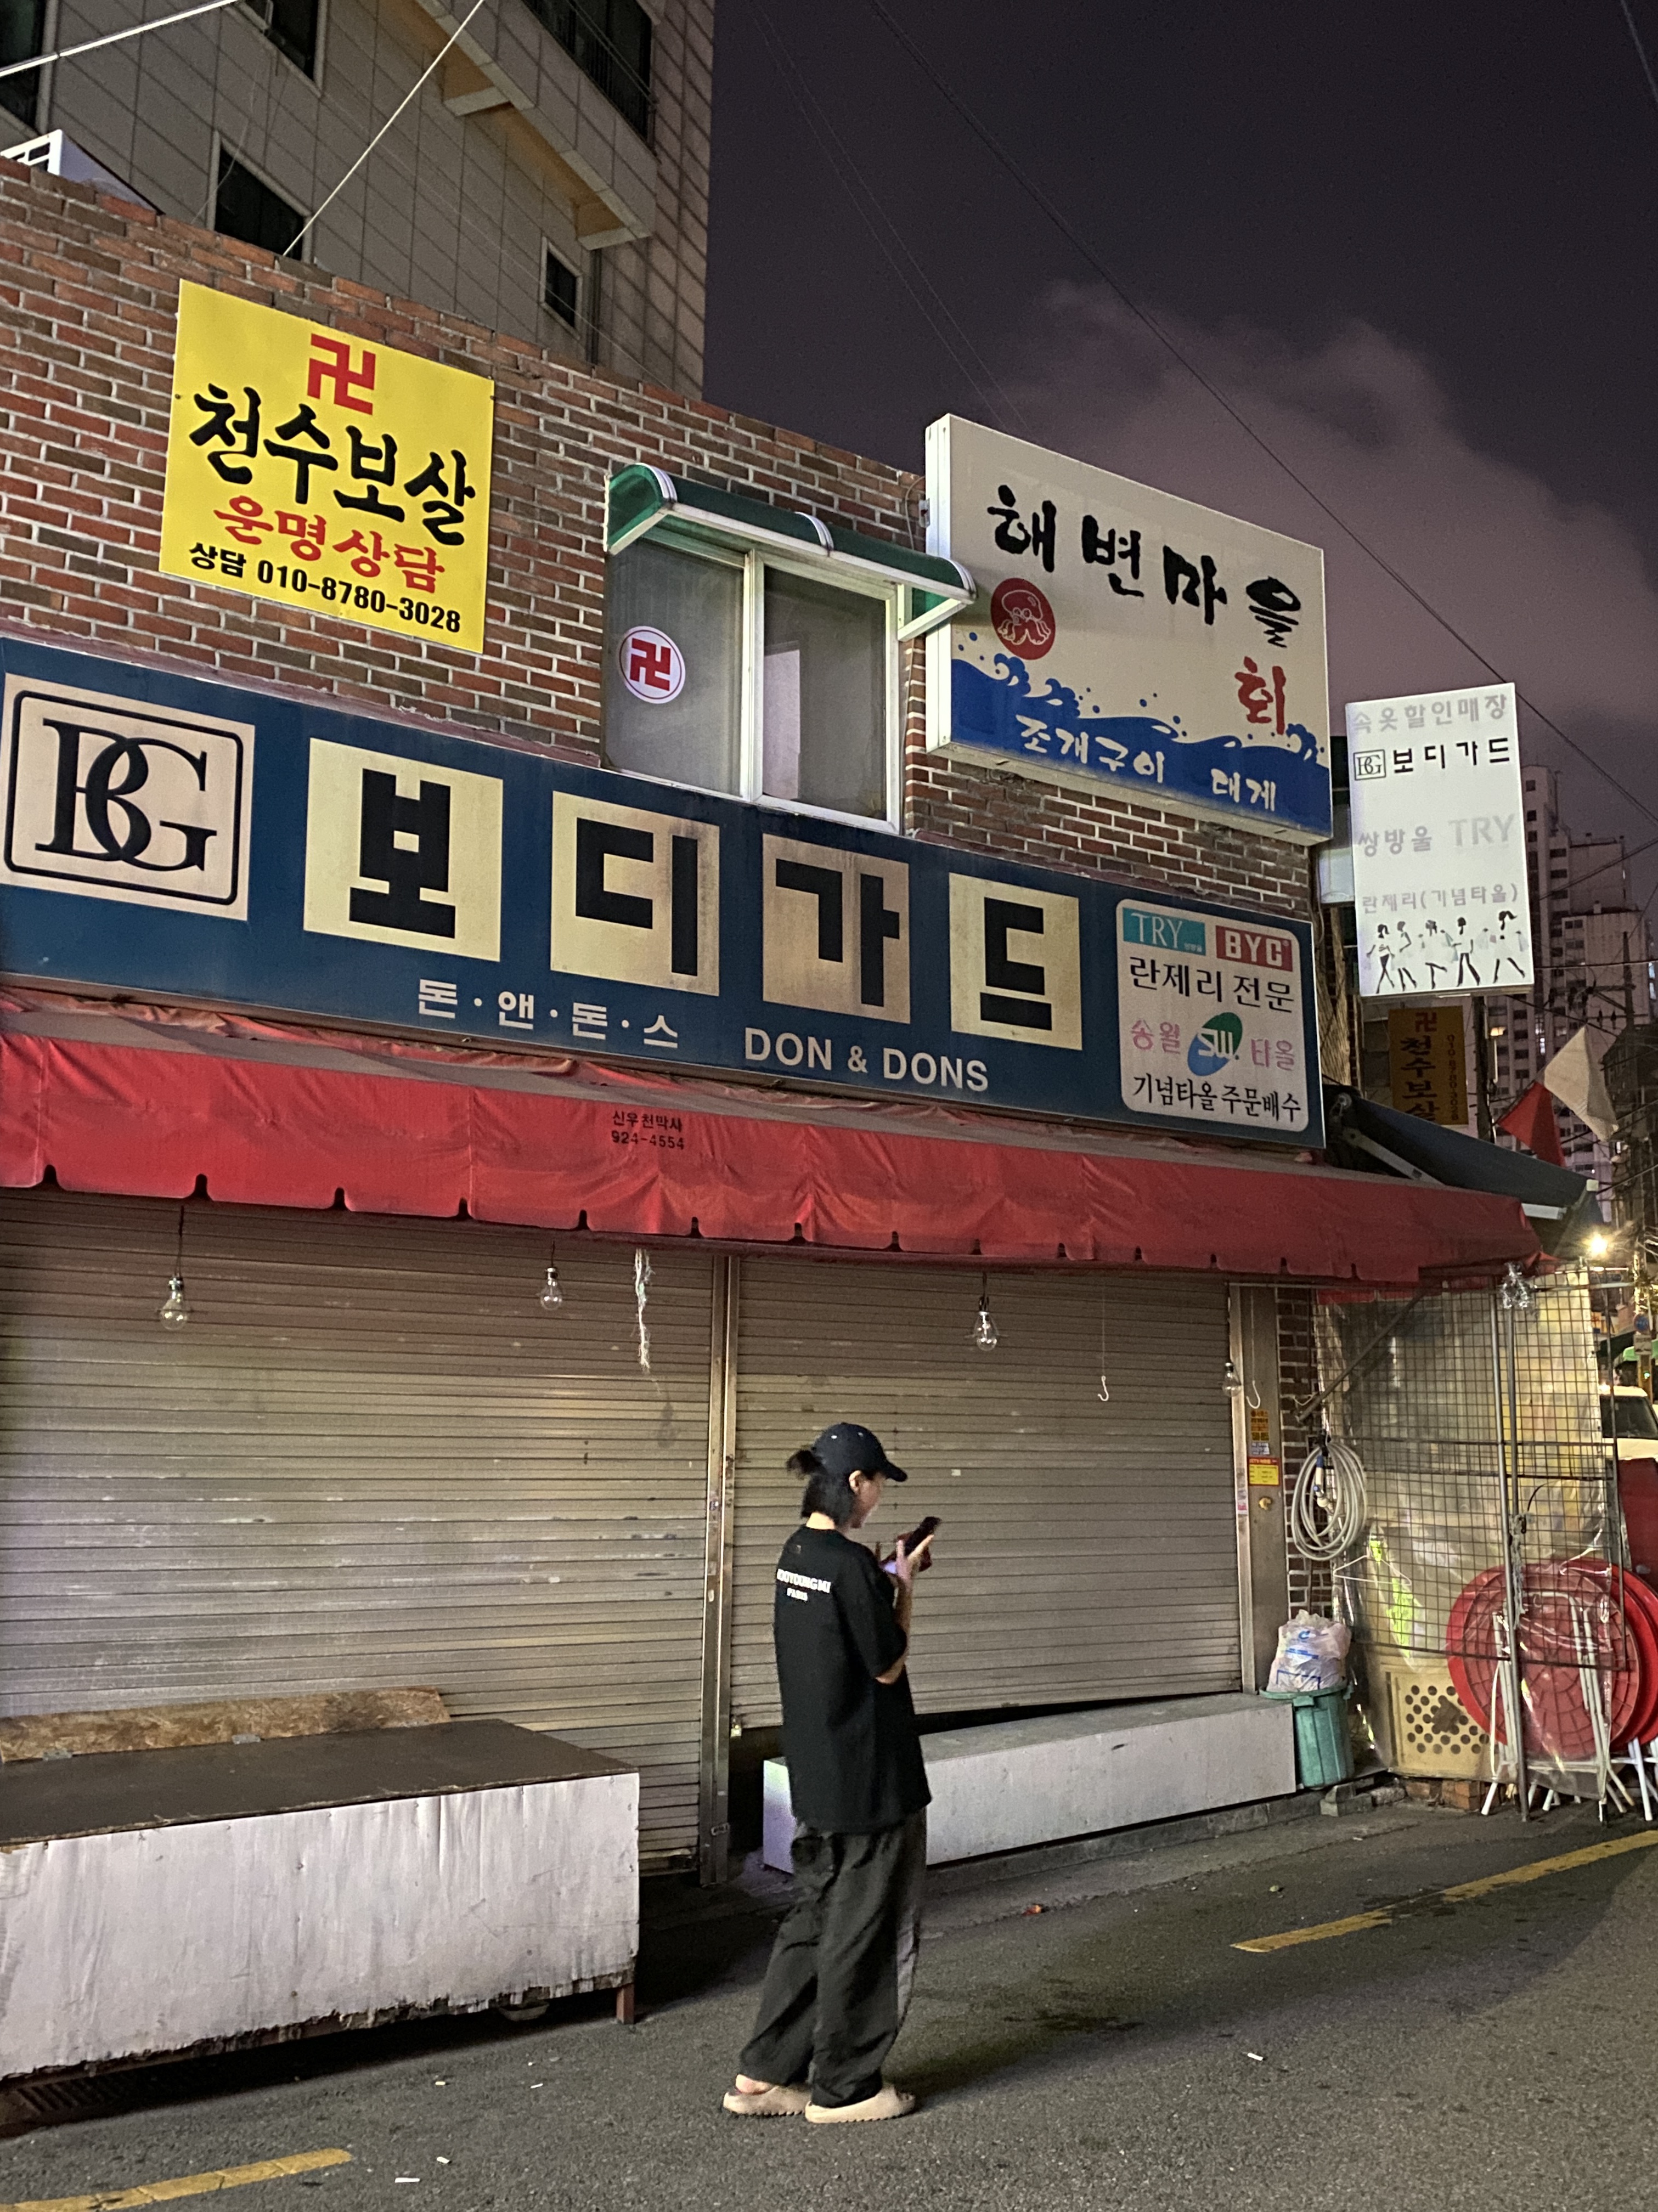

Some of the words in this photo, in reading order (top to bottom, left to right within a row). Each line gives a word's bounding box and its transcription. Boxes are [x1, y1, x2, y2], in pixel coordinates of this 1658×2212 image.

[189, 383, 476, 545] 천수보살
[189, 541, 246, 578] 상담
[258, 560, 460, 633] 010-8780-3028
[988, 484, 1301, 648] 해변마을
[1234, 656, 1287, 735] 회
[1016, 714, 1165, 783] 조개구이
[1211, 769, 1276, 811] 대게
[1393, 737, 1510, 774] 보디가드
[1358, 825, 1432, 857] 쌍방울
[1448, 814, 1515, 847] TRY
[1130, 912, 1183, 949] TRY
[1225, 930, 1283, 967] BYC
[1129, 956, 1222, 1003] 란제리
[1233, 975, 1294, 1013] 전문
[745, 1028, 832, 1071] DON
[848, 1045, 868, 1074] &
[883, 1047, 989, 1092] DONS
[612, 1130, 684, 1150] 924-4554
